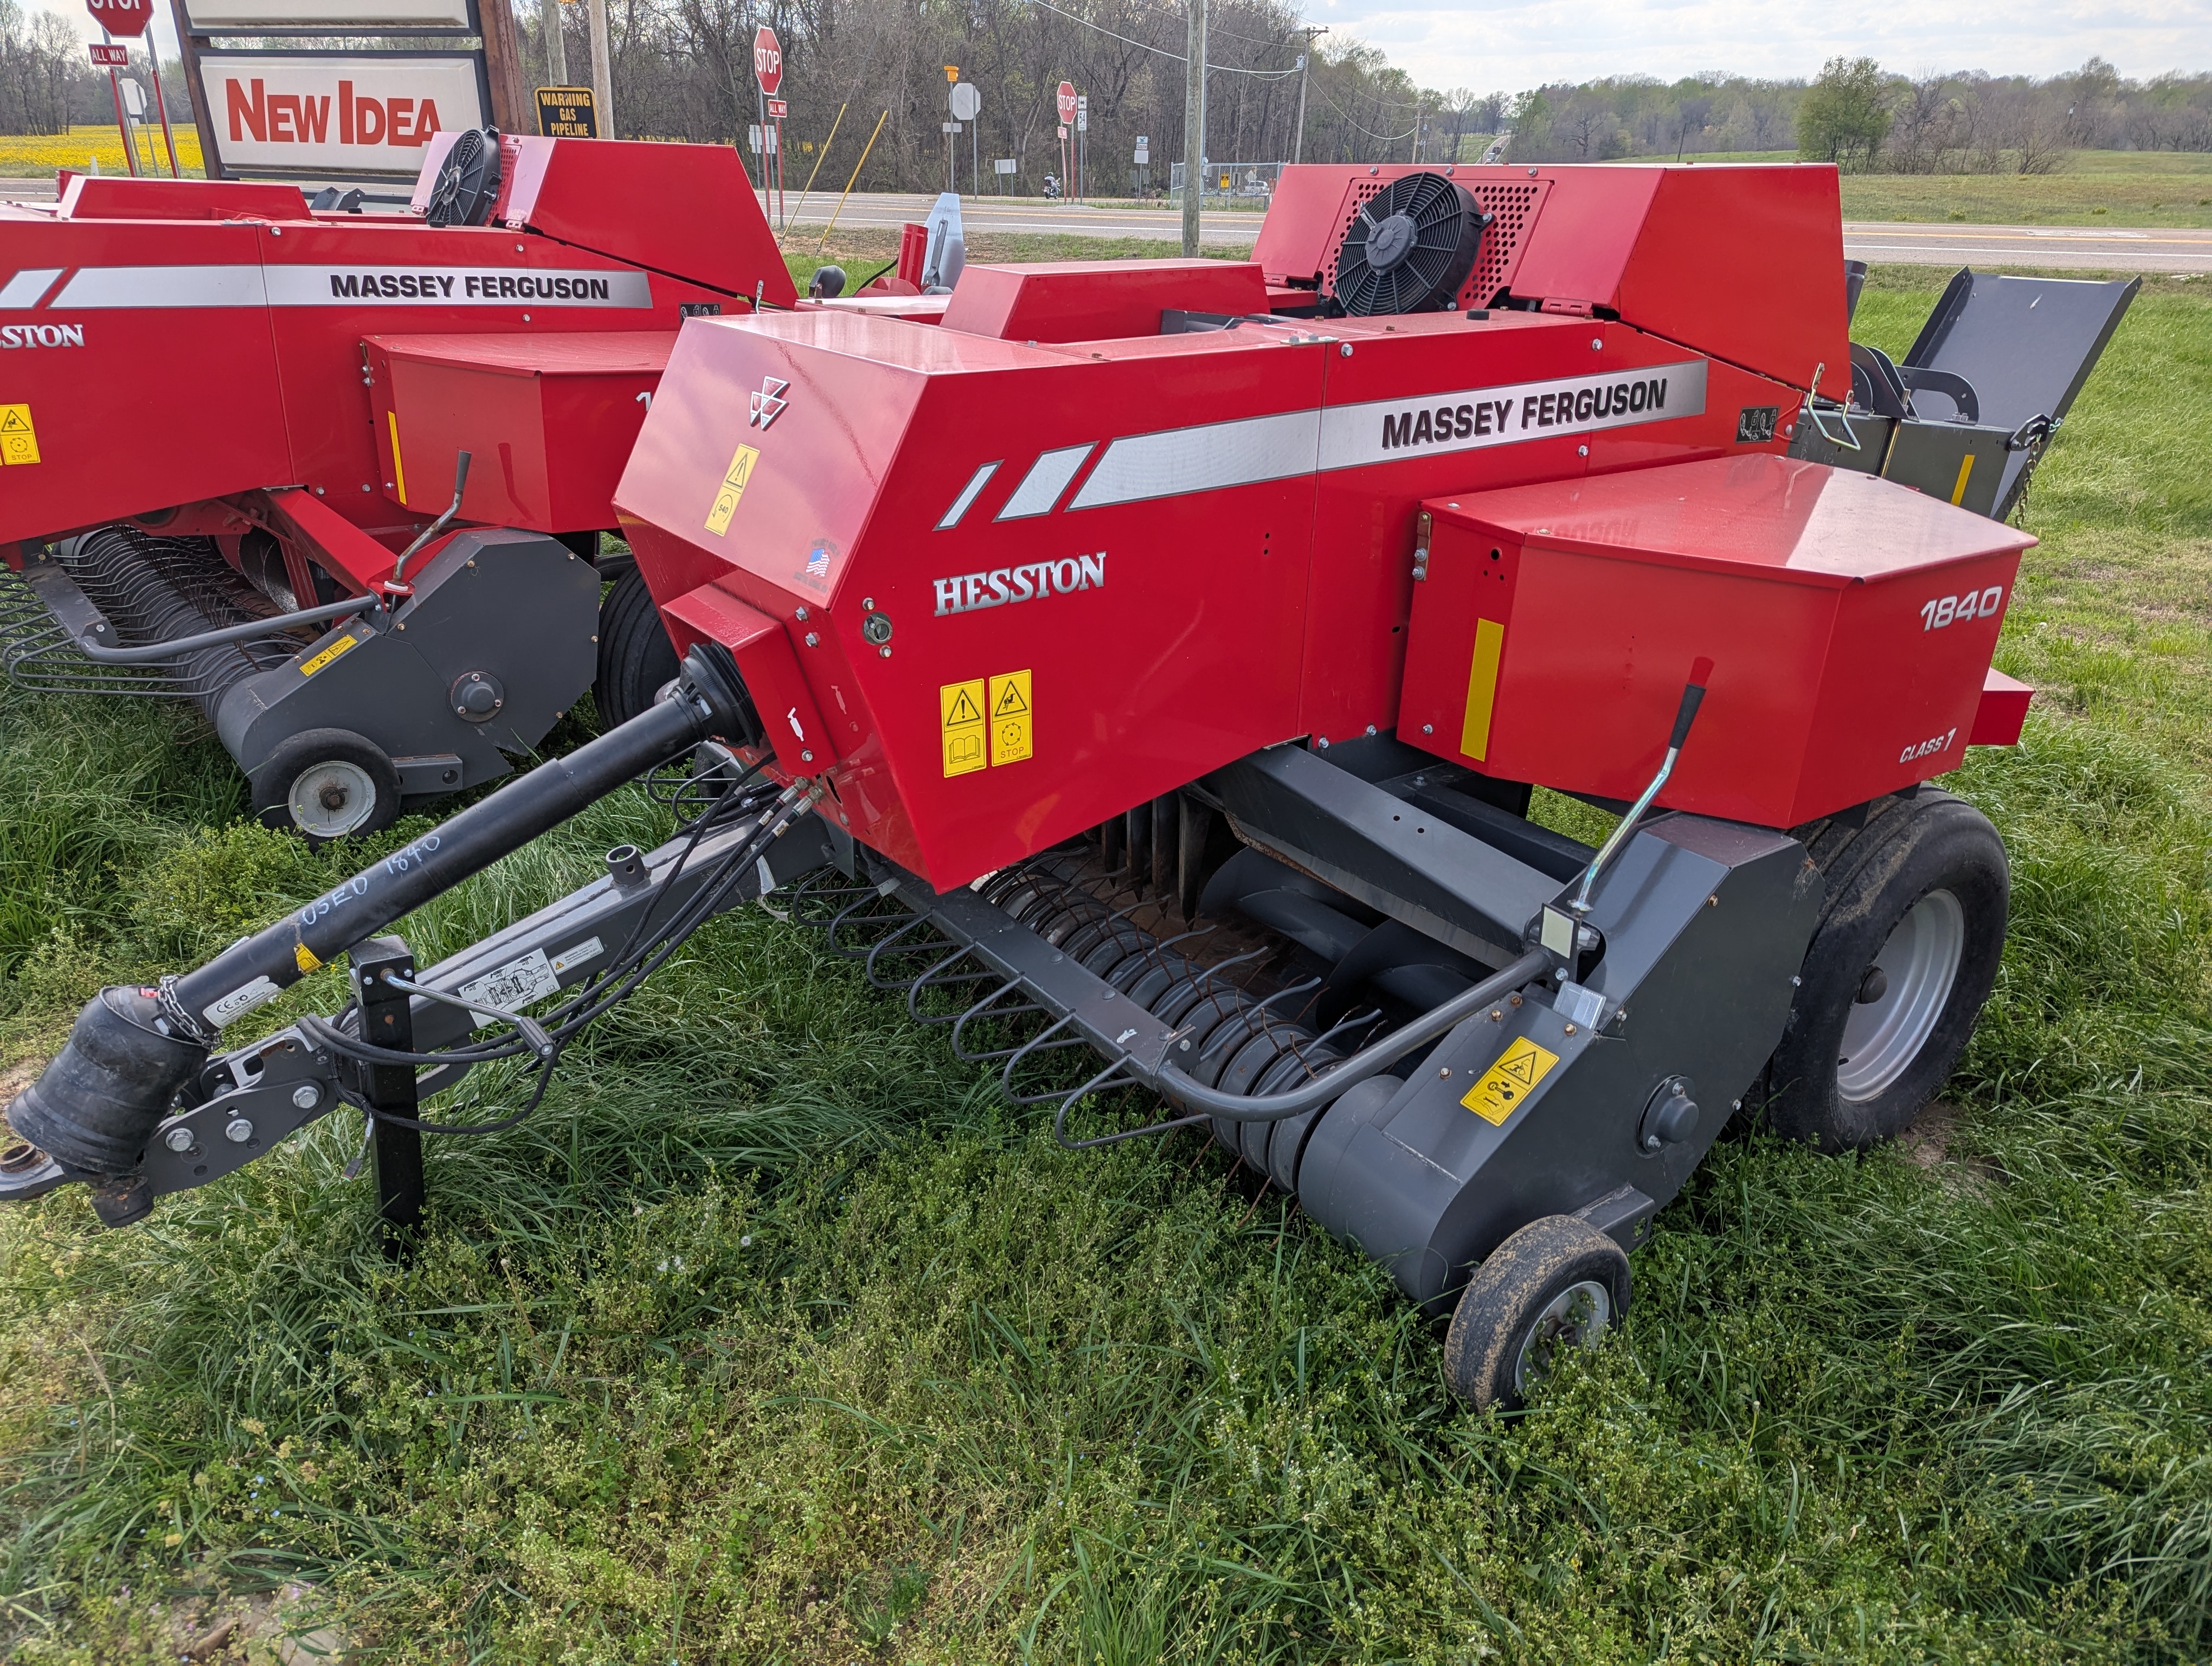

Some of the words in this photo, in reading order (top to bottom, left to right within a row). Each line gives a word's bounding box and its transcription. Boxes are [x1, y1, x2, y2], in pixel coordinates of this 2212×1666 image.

[92, 48, 108, 61] ALL
[108, 49, 126, 62] WAY
[756, 47, 780, 74] STOP
[539, 92, 591, 107] WARNING
[769, 103, 777, 113] ALL
[1058, 94, 1076, 112] STOP
[559, 107, 576, 121] GAS
[1079, 113, 1085, 124] 54
[550, 123, 589, 136] PIPELINE
[330, 274, 455, 298] MASSEY
[465, 276, 610, 300] FERGUSON
[0, 324, 85, 349] STON
[1381, 399, 1514, 451] MASSEY
[1521, 378, 1669, 430] FERGUSON
[718, 504, 729, 514] 540
[933, 550, 1107, 617] HESSTON
[1920, 585, 2003, 632] 1840
[1000, 746, 1025, 759] STOP
[1899, 735, 1945, 764] CLASS
[1943, 727, 1957, 752] 1
[302, 876, 368, 925] USED
[385, 836, 440, 875] 1840
